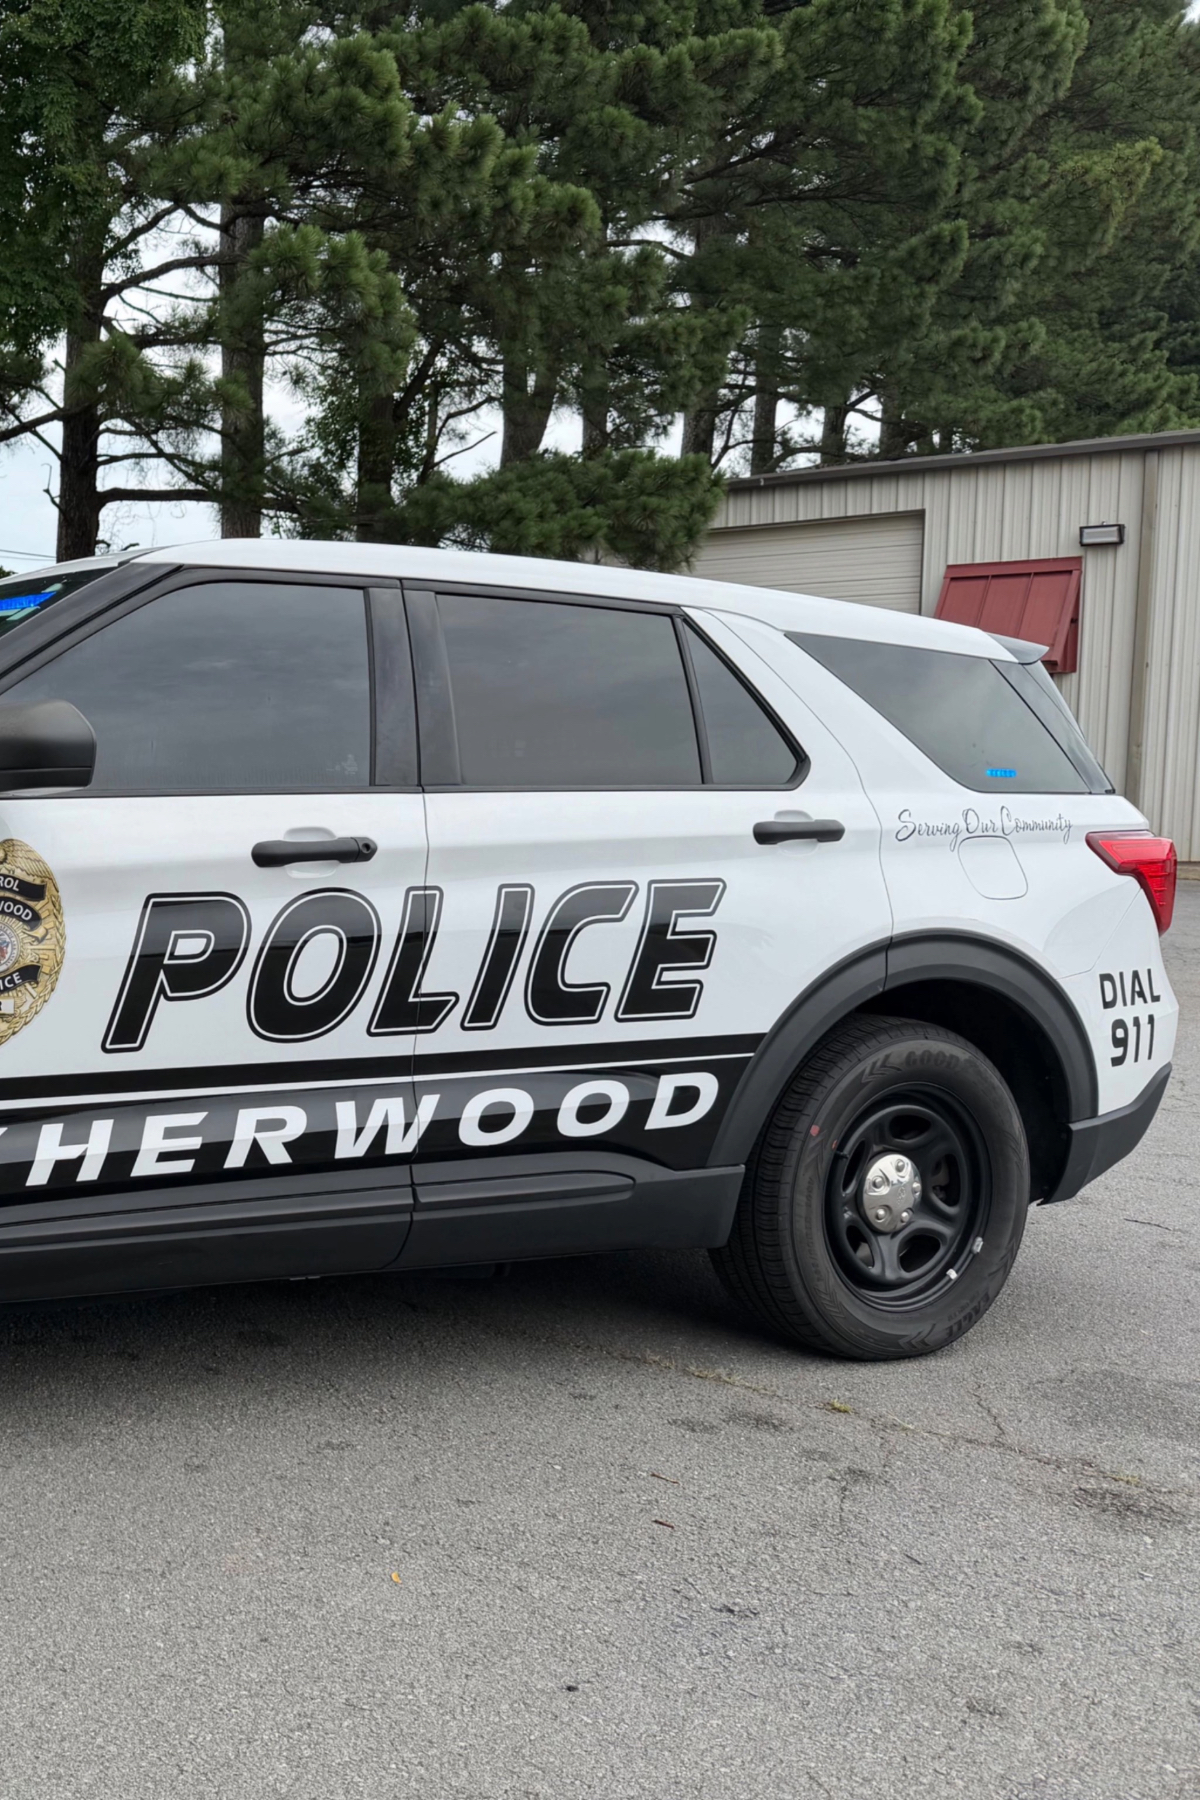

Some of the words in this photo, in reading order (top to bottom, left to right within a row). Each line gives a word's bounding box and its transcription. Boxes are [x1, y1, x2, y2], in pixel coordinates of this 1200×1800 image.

[895, 809, 962, 852] Serving
[962, 808, 998, 834] Our
[1000, 805, 1073, 844] Community
[101, 877, 727, 1054] POLICE
[1099, 968, 1161, 1010] DIAL
[1110, 1014, 1156, 1067] 911
